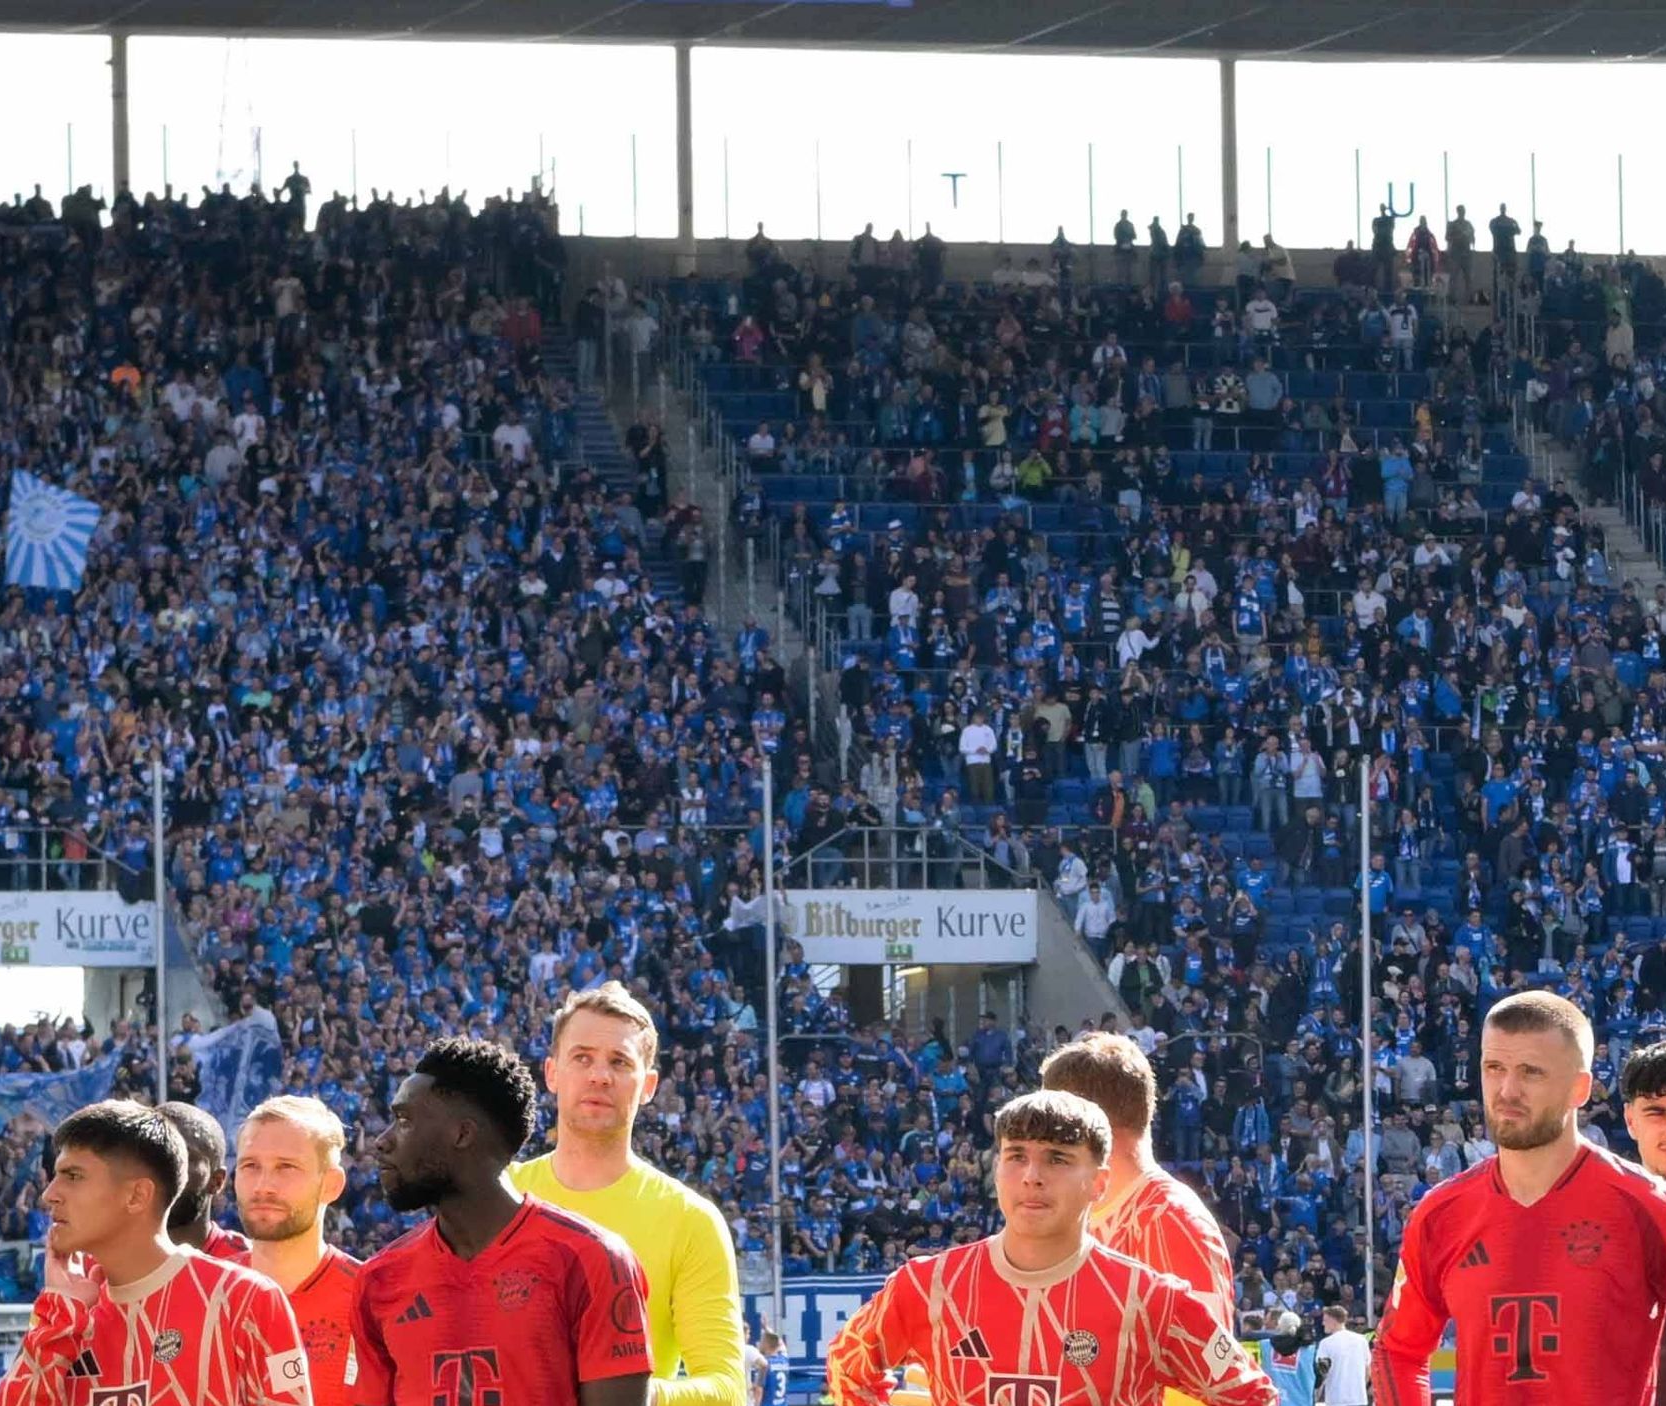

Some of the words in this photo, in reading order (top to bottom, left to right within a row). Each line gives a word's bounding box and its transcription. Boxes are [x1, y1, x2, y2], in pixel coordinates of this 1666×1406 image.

[56, 906, 151, 940] Kurve
[804, 901, 923, 943] Bitburger
[937, 905, 1027, 938] Kurve
